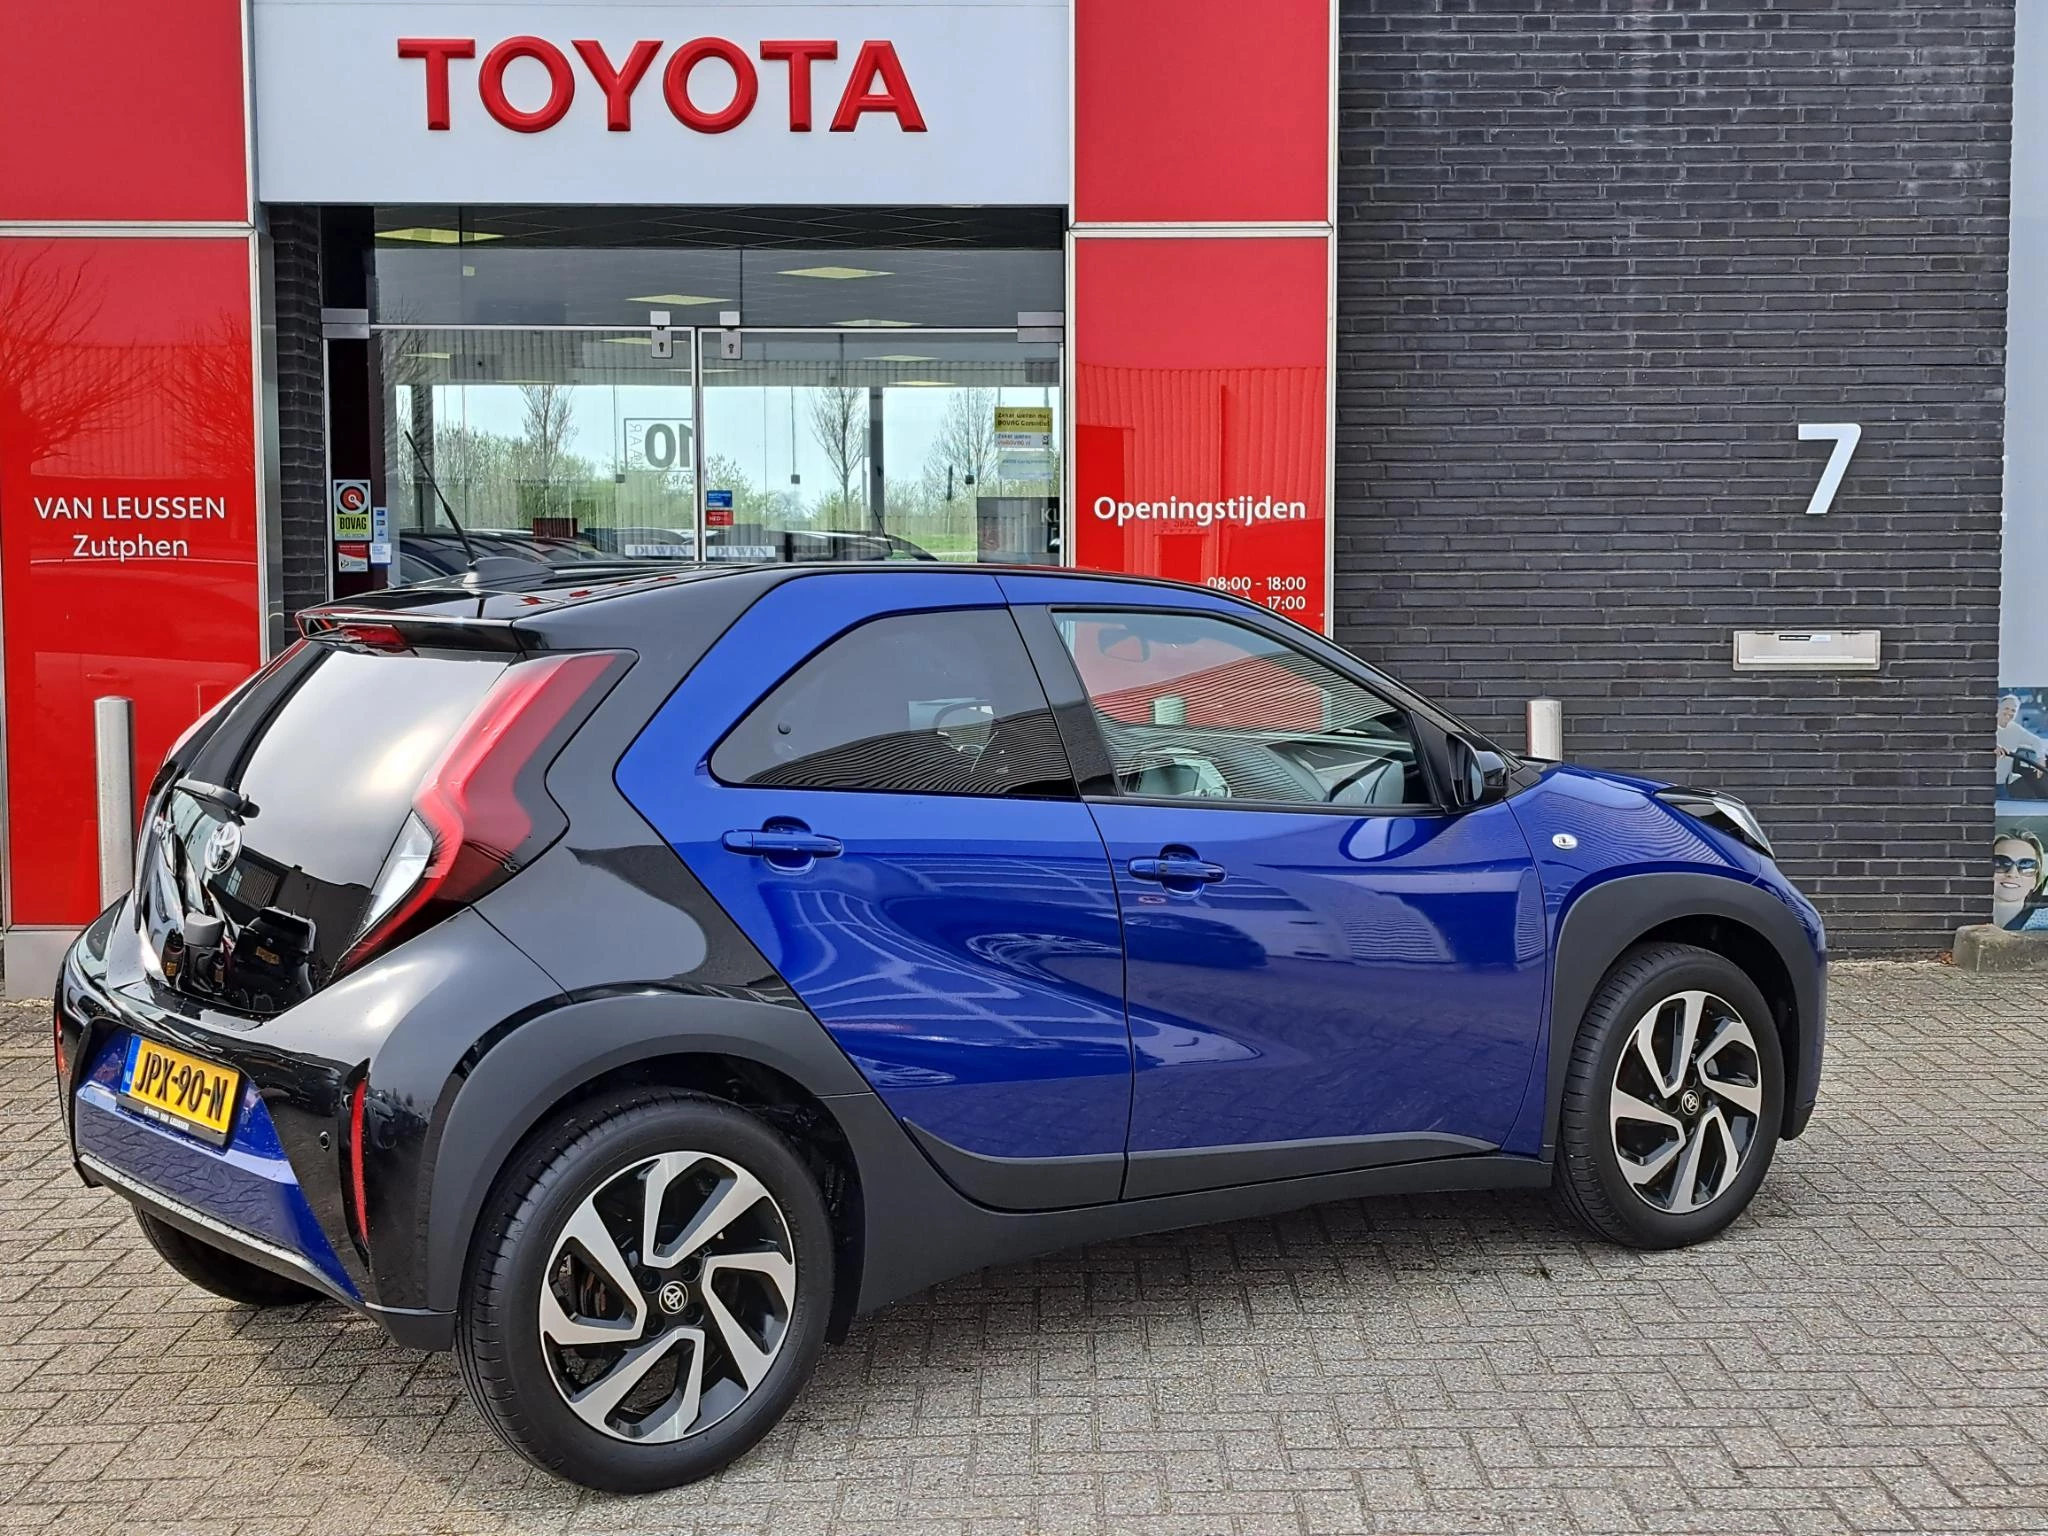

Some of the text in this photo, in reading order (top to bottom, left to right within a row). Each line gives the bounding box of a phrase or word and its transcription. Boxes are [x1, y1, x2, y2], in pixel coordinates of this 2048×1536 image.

[397, 36, 928, 134] TOYOTA
[1798, 423, 1862, 514] 7
[33, 496, 226, 519] VAN LEUSSEN
[1093, 496, 1306, 526] Openingstijden
[340, 517, 367, 530] BOVAG
[72, 533, 189, 562] Zutphen
[715, 546, 768, 557] DUWEN
[1207, 576, 1252, 590] 08:00
[1266, 576, 1306, 590] 18:00
[1266, 596, 1306, 610] 17:00
[134, 1051, 228, 1122] JPX-90-N
